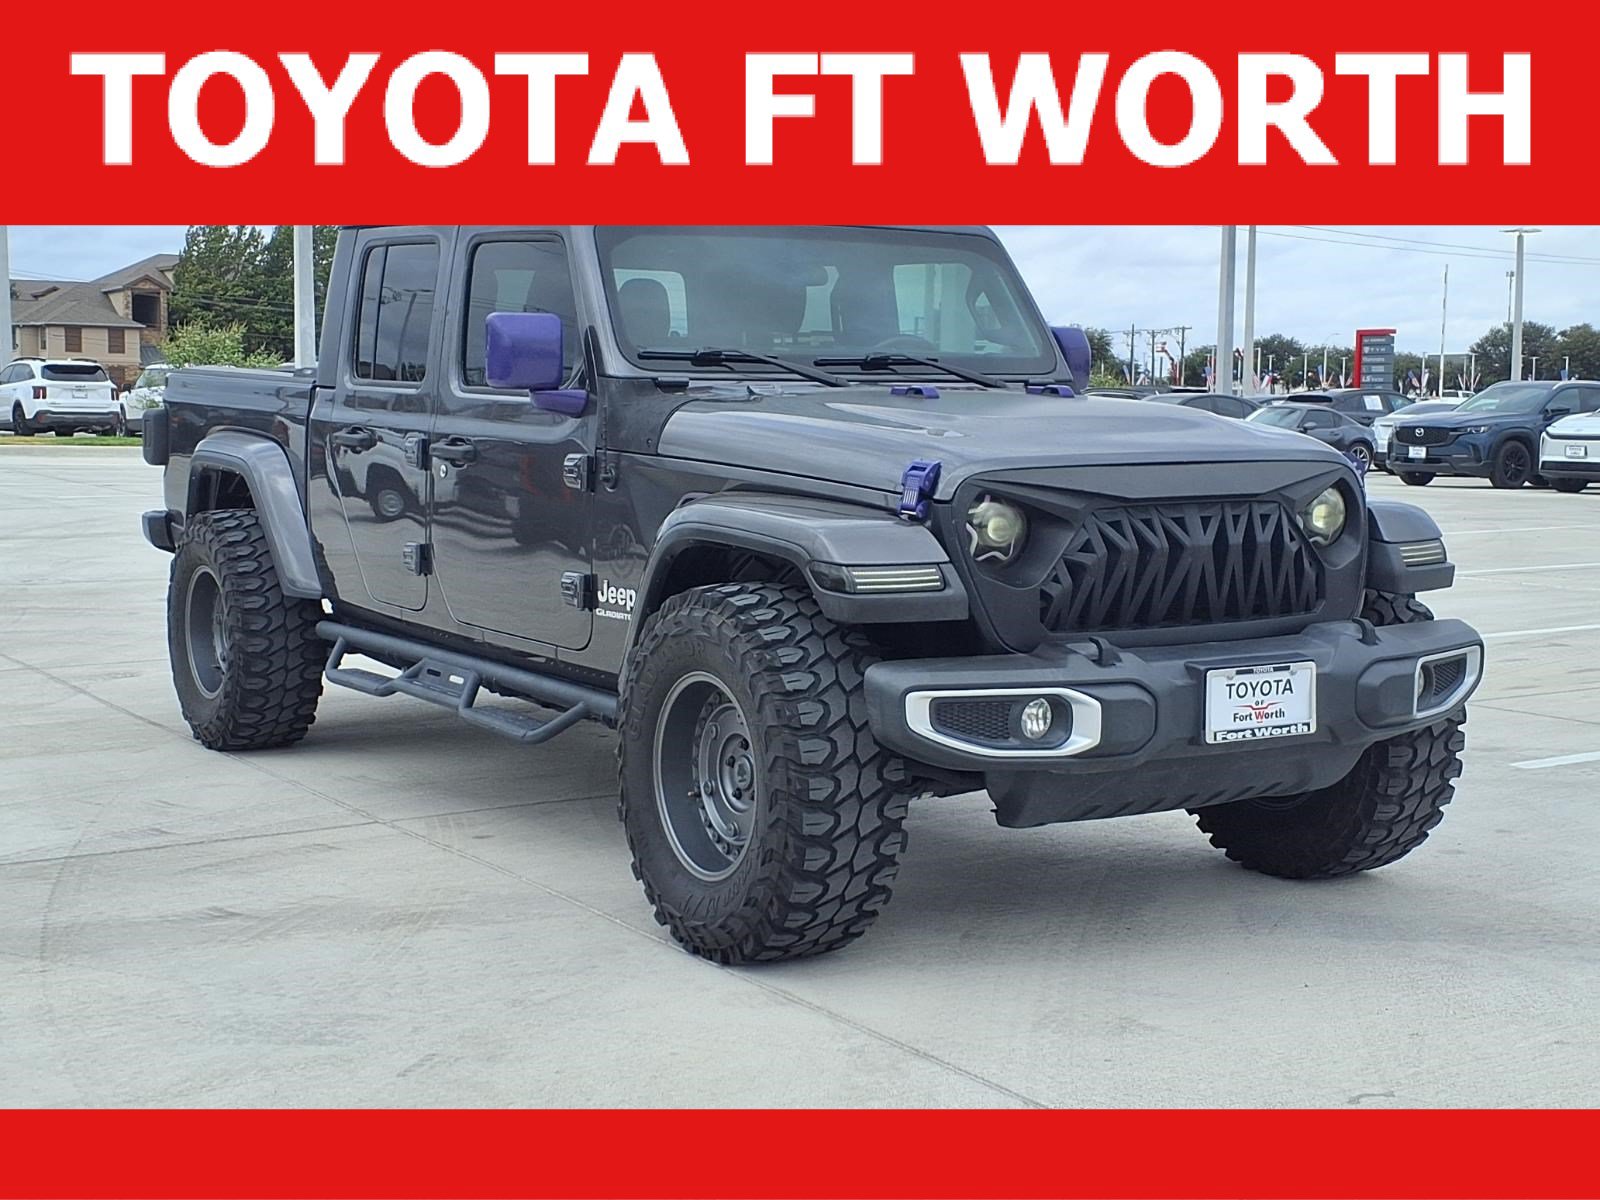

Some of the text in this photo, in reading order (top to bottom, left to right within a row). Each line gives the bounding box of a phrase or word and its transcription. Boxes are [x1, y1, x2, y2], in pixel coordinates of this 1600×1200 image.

[597, 579, 636, 611] Jeep
[1226, 678, 1294, 699] TOYOTA
[1233, 708, 1285, 723] Fort Worth
[1215, 722, 1309, 741] Fort Worth
